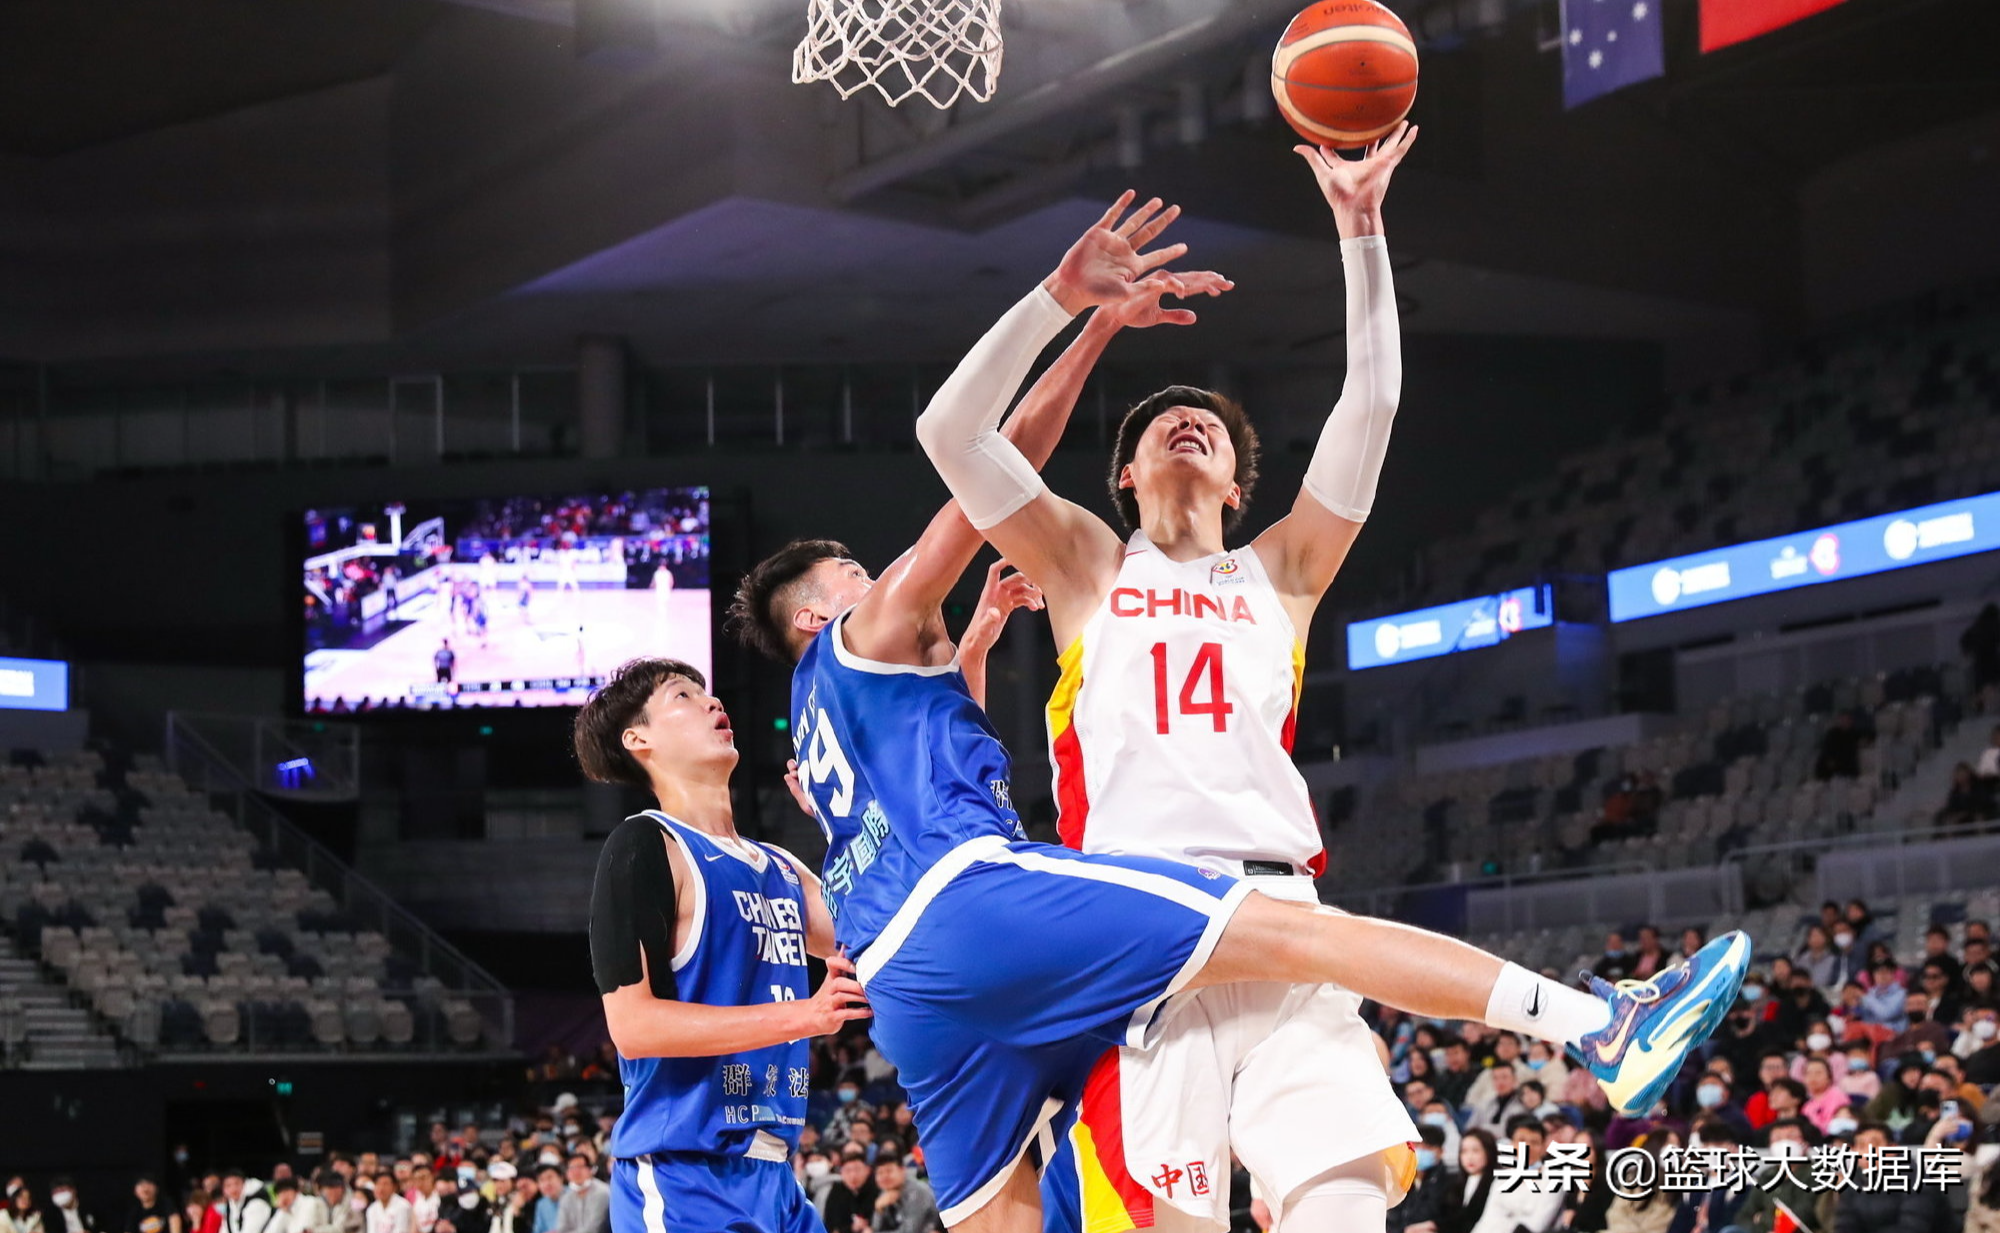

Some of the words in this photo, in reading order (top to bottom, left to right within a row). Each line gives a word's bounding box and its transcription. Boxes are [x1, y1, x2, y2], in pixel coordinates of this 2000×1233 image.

[1111, 587, 1257, 625] CHINA
[1150, 642, 1233, 734] 14
[752, 926, 808, 966] TAIPEI
[1151, 1160, 1210, 1199] 中国
